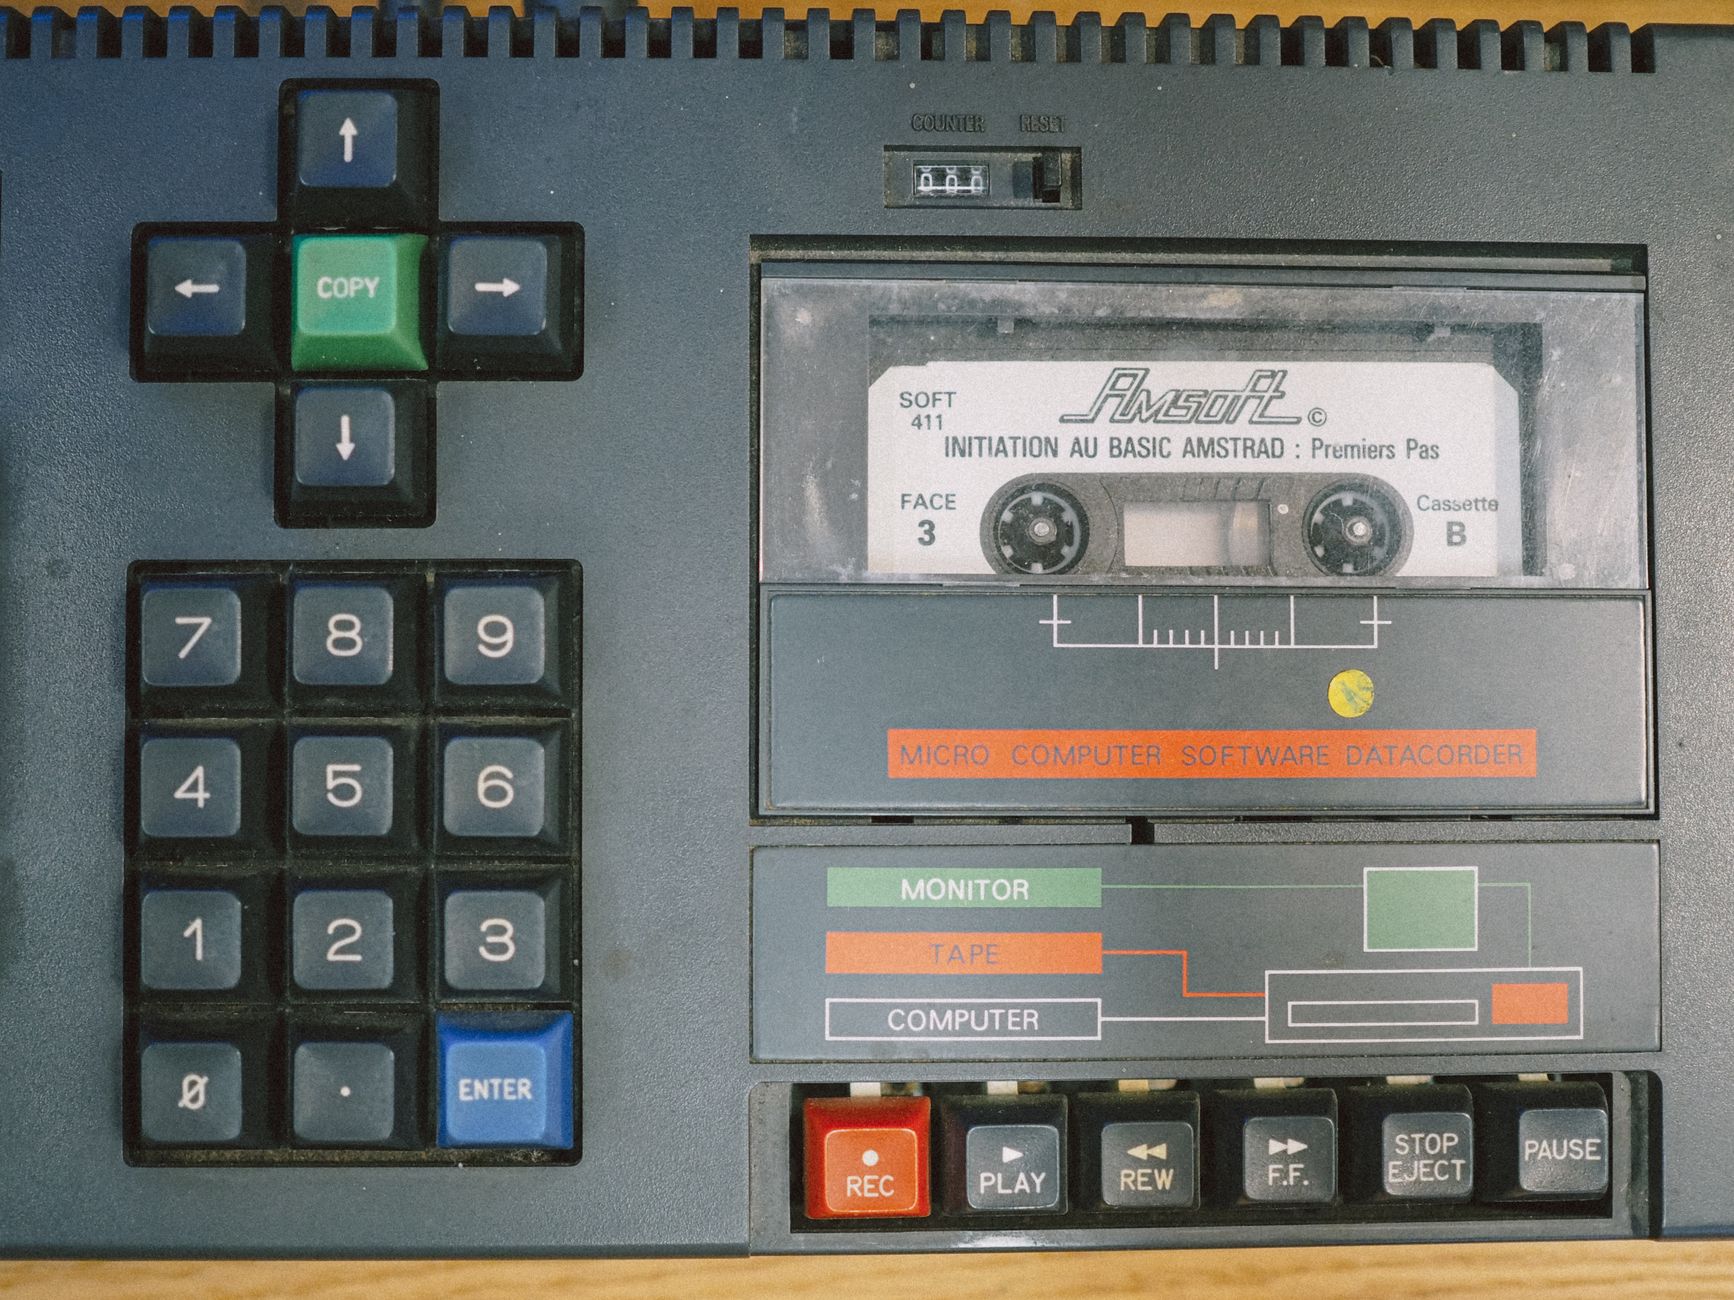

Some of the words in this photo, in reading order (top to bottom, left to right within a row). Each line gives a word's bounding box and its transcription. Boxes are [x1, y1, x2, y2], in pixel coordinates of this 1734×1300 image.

[911, 113, 985, 132] COUNTER
[1020, 114, 1065, 132] RESET
[317, 276, 380, 299] COPY
[900, 391, 957, 408] SOFT
[911, 414, 943, 431] 411
[944, 436, 1059, 459] INITIATION
[1069, 436, 1098, 459] AU
[1109, 436, 1172, 459] BASIC
[1182, 436, 1285, 460] AMSTRAD
[1311, 439, 1396, 461] Premiers
[1406, 440, 1440, 460] Pas
[900, 493, 957, 511] FACE
[1416, 493, 1499, 512] Cassette
[917, 520, 936, 546] 3
[1446, 521, 1466, 546] B
[175, 617, 211, 659] 7
[326, 613, 363, 657] 8
[476, 614, 514, 658] 9
[900, 744, 990, 766] MICRO
[1011, 744, 1161, 766] COMPUTER
[1182, 744, 1329, 766] SOFTWARE
[1346, 744, 1524, 766] DATACORDER
[173, 765, 210, 808] 4
[326, 764, 362, 807] 5
[476, 765, 514, 808] 6
[900, 877, 1029, 903] MONITOR
[183, 918, 203, 961] 1
[326, 918, 362, 961] 2
[477, 918, 515, 962] 3
[929, 942, 999, 965] TAPE
[887, 1007, 1040, 1032] COMPUTER
[458, 1078, 532, 1101] ENTER
[1395, 1133, 1459, 1155] STOP
[1524, 1138, 1601, 1161] PAUSE
[979, 1171, 1046, 1196] PLAY
[1120, 1168, 1174, 1192] REW
[1267, 1165, 1309, 1188] F.F.
[1388, 1160, 1465, 1184] EJECT
[846, 1175, 895, 1199] REC
